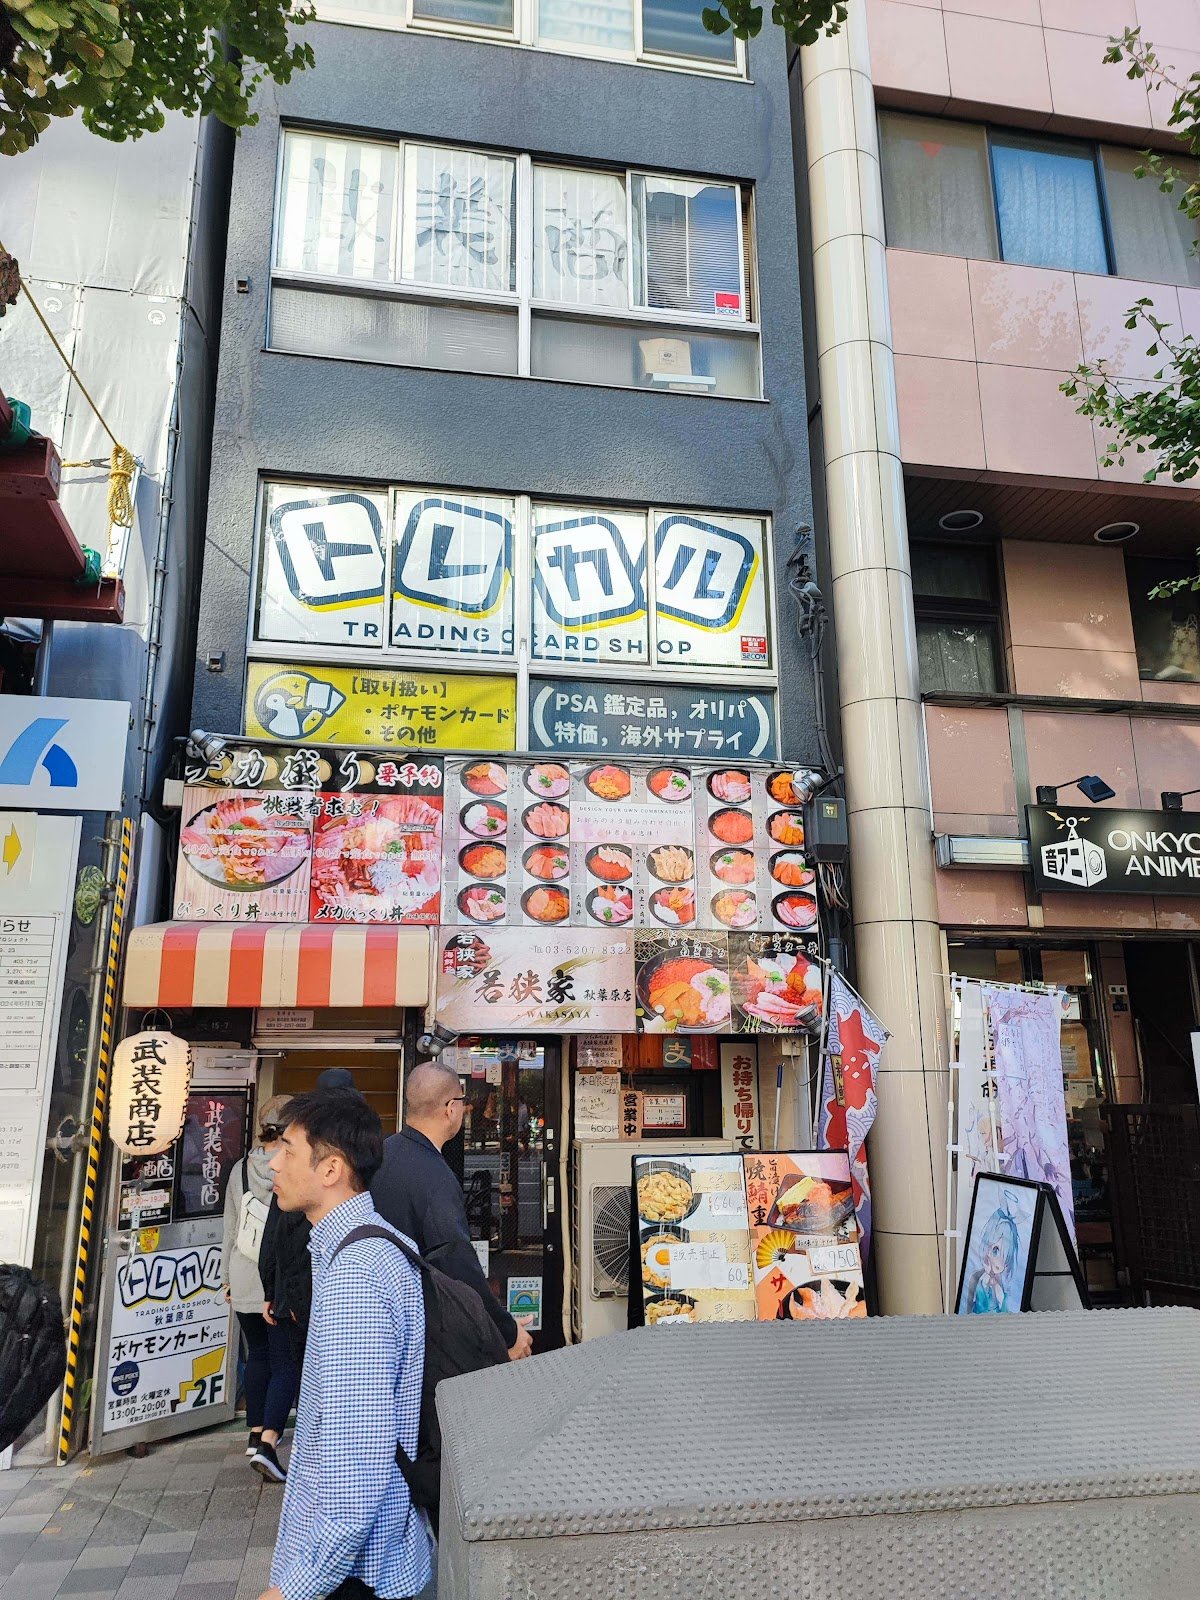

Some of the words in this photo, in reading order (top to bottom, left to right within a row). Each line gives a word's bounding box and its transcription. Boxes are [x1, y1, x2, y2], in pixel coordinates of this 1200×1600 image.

[343, 620, 490, 643] TRADING
[608, 638, 692, 656] SHOP
[742, 652, 766, 660] SECOM
[555, 693, 598, 714] PSA
[375, 762, 442, 788] 要予約
[1046, 848, 1083, 878] 音アニ
[176, 901, 260, 919] びっくり丼
[456, 931, 476, 979] 若狭家
[474, 969, 576, 1004] 若狭家
[583, 988, 631, 1002] 秋葉原店
[527, 1010, 590, 1019] WAKASAYA
[664, 1042, 692, 1064] 支
[125, 1038, 168, 1147] 武装商店
[732, 1055, 755, 1149] お持ち帰りで
[623, 1093, 638, 1137] 営業中
[201, 1101, 225, 1206] 武装商店
[673, 1246, 720, 1261] 販売中止
[136, 1306, 169, 1317] TRADING
[171, 1303, 191, 1311] CARD
[192, 1298, 211, 1307] SHOP
[154, 1310, 194, 1326] 秋葉原店
[192, 1374, 224, 1408] 2F
